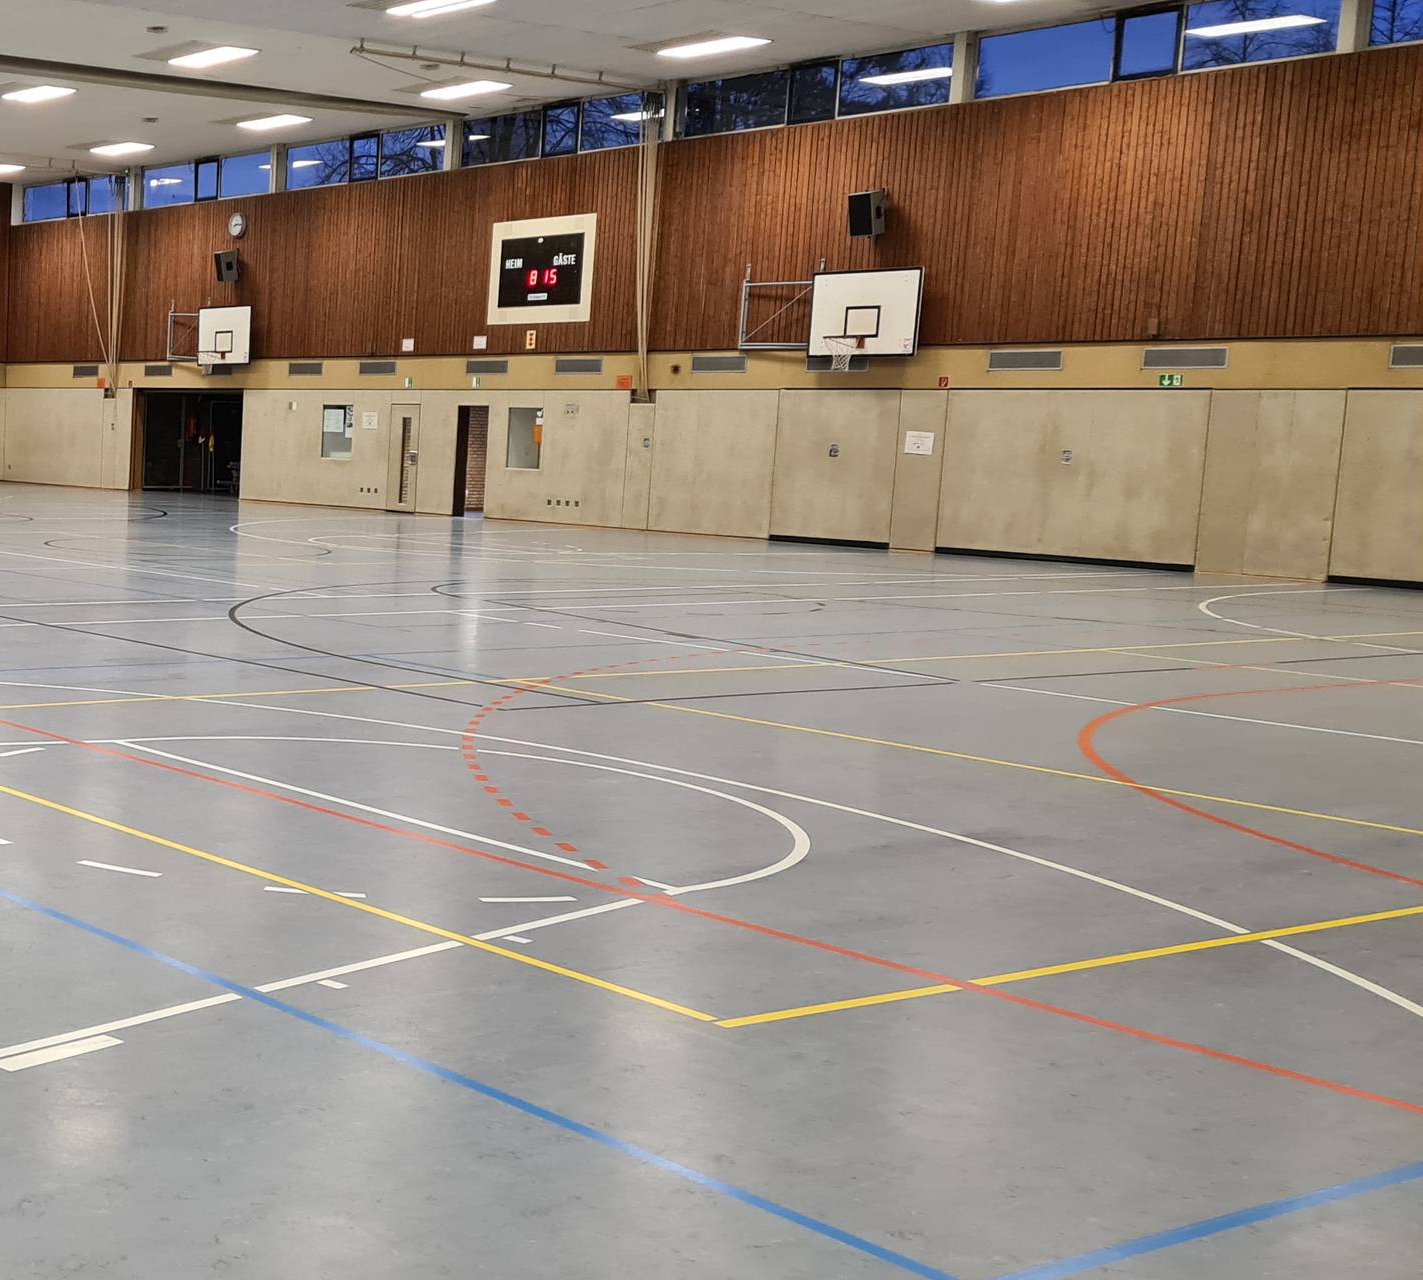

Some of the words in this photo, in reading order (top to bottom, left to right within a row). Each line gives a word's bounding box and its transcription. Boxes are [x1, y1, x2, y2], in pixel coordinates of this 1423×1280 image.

[505, 258, 523, 269] HEIM
[553, 253, 576, 266] GÄSTE
[530, 270, 538, 285] 8
[544, 269, 558, 284] 15
